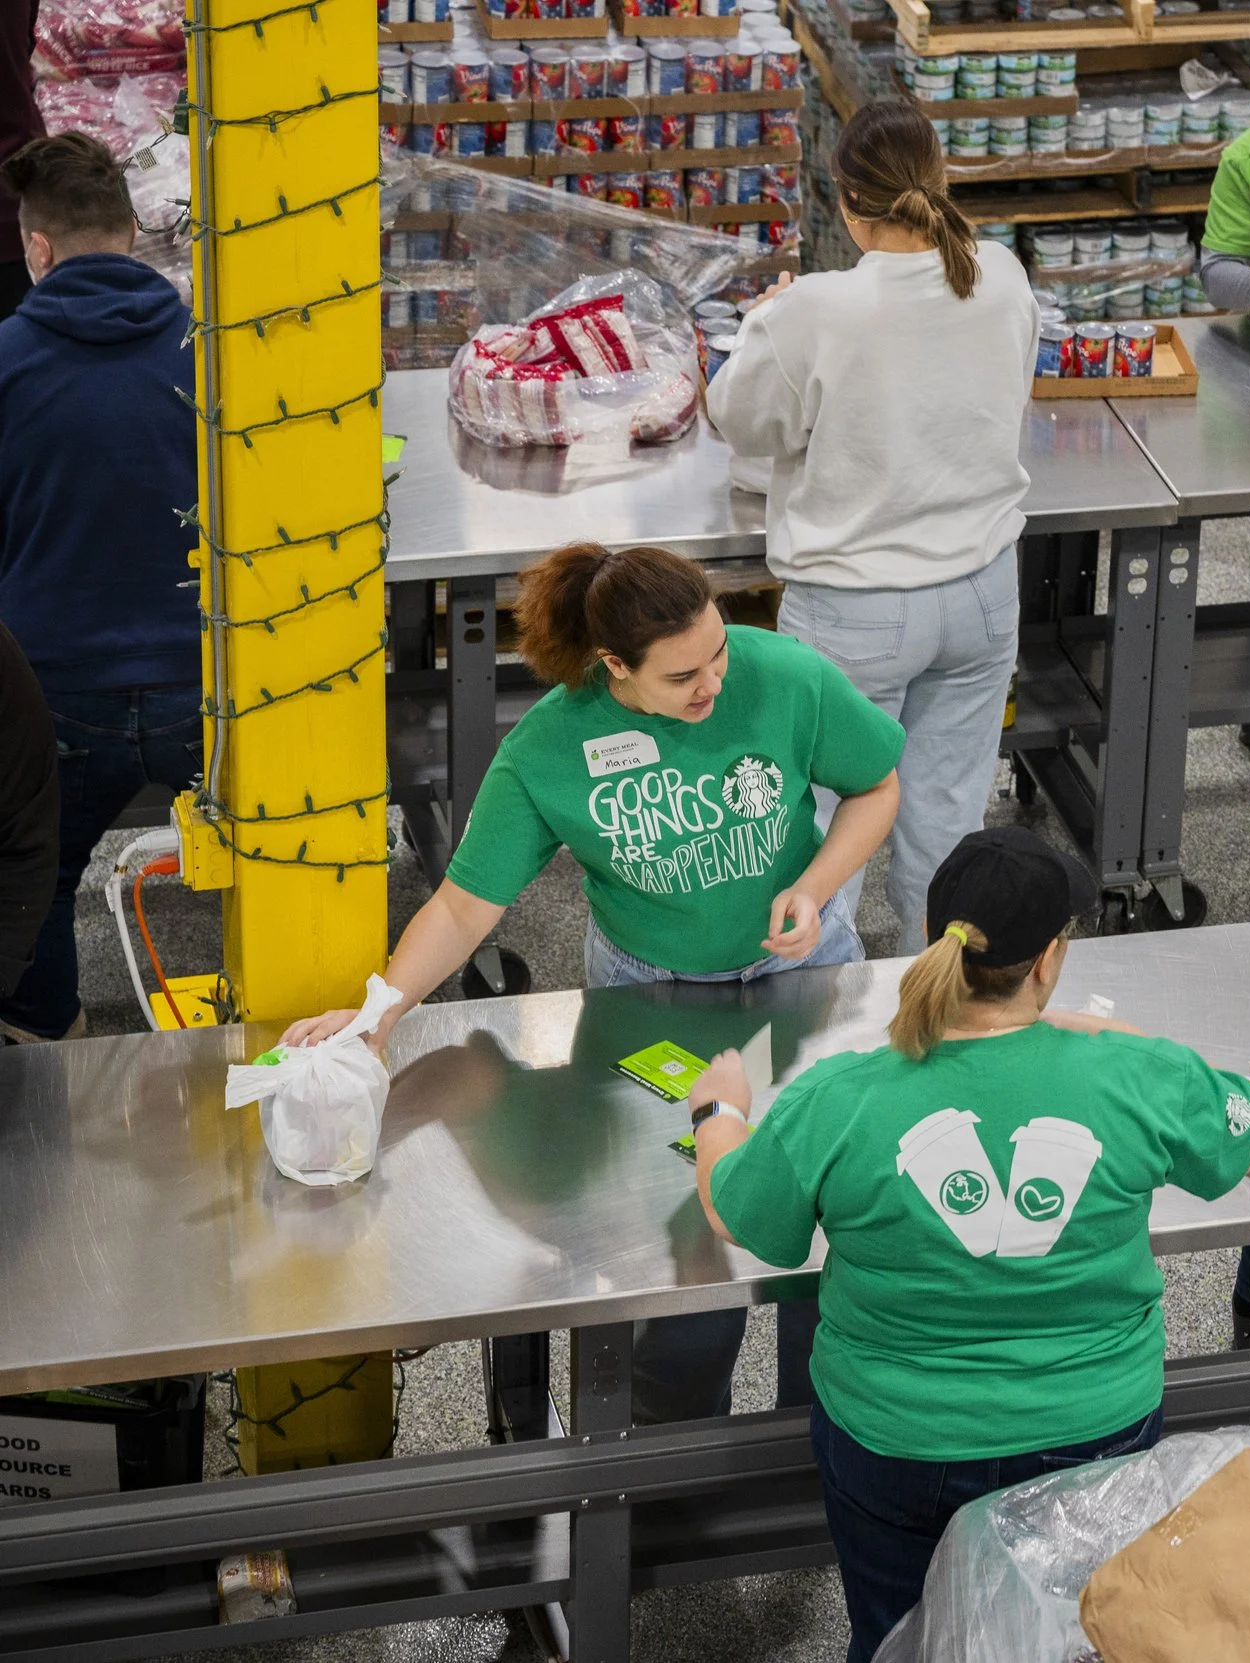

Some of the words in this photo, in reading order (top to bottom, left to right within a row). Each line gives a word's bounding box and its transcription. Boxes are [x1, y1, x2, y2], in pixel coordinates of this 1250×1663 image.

[1118, 338, 1138, 358] Ripe
[601, 746, 620, 754] EVERY
[621, 742, 639, 750] MEAL
[605, 756, 641, 770] Maria
[588, 768, 683, 831] GOOD
[598, 774, 724, 846] THINGS
[610, 804, 790, 894] HAPPENING
[610, 842, 662, 864] ARE
[0, 1459, 72, 1477] OURCE
